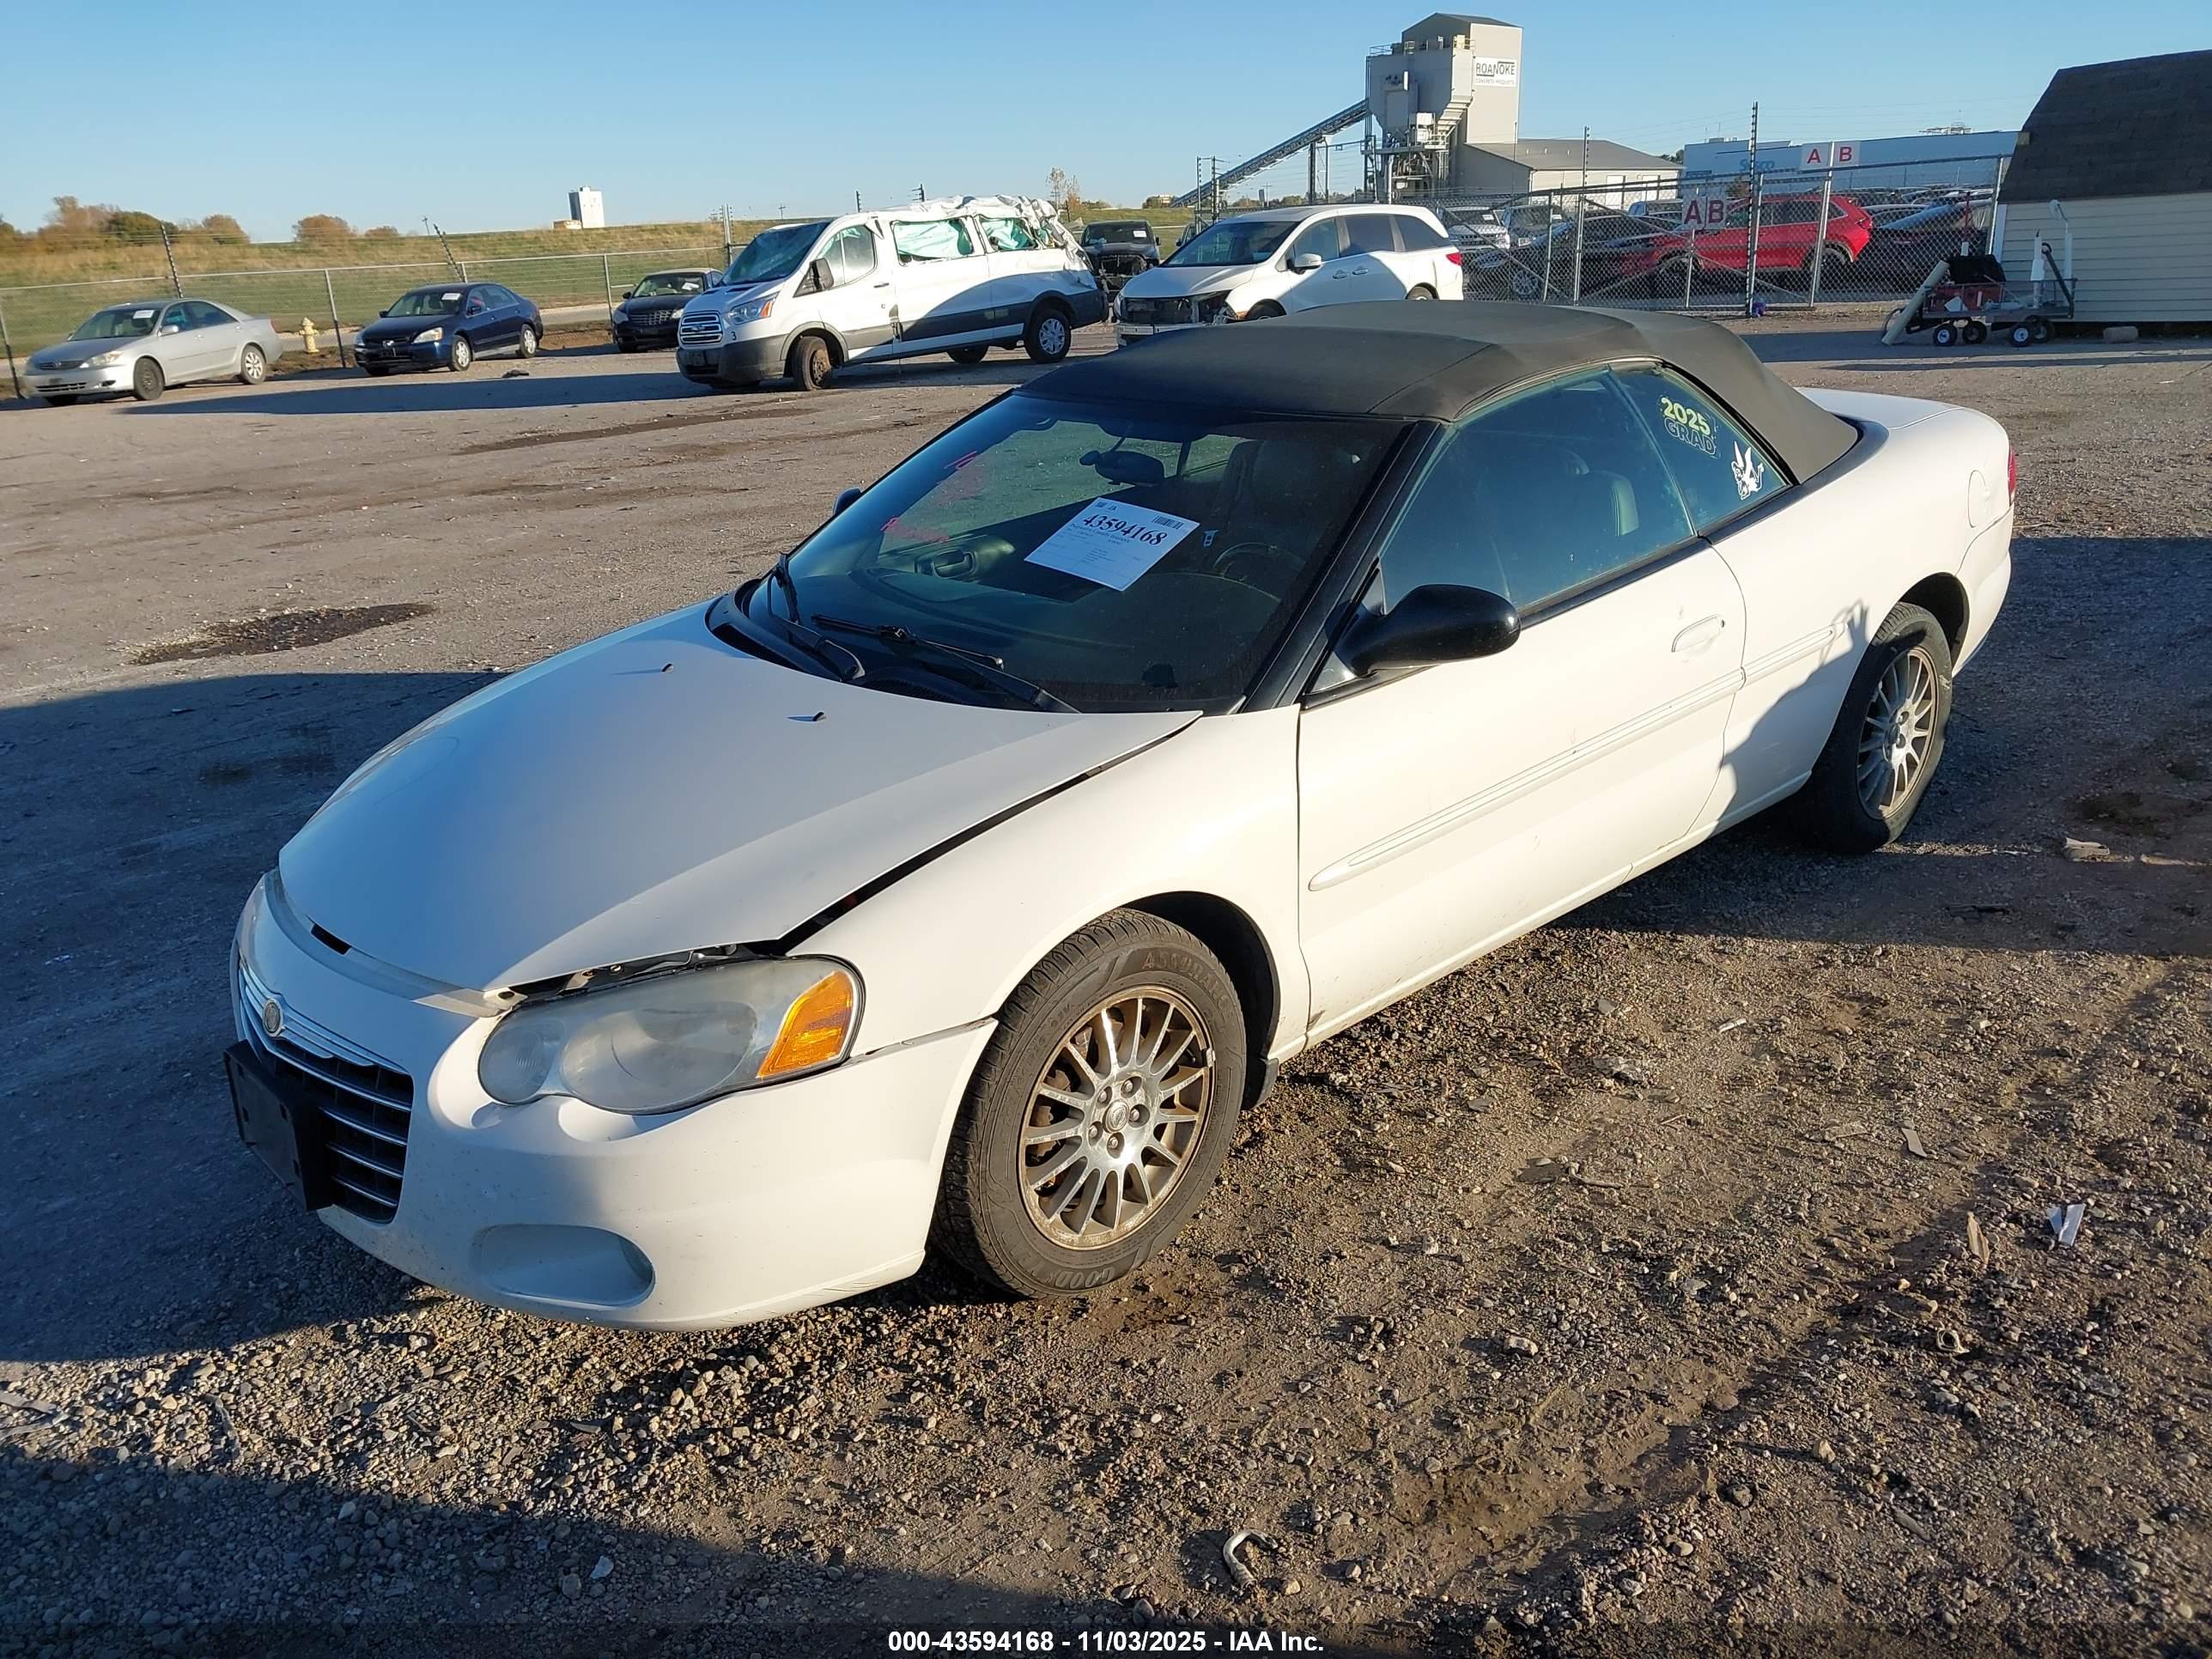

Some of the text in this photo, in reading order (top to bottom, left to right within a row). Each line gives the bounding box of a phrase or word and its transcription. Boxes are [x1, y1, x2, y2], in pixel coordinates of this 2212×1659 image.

[1475, 62, 1516, 76] ROANOKE
[1807, 147, 1852, 164] A B
[1684, 199, 1724, 224] A B
[1661, 397, 1711, 435] 2025
[1664, 417, 1717, 455] GRAD
[1084, 514, 1168, 546] 43594168
